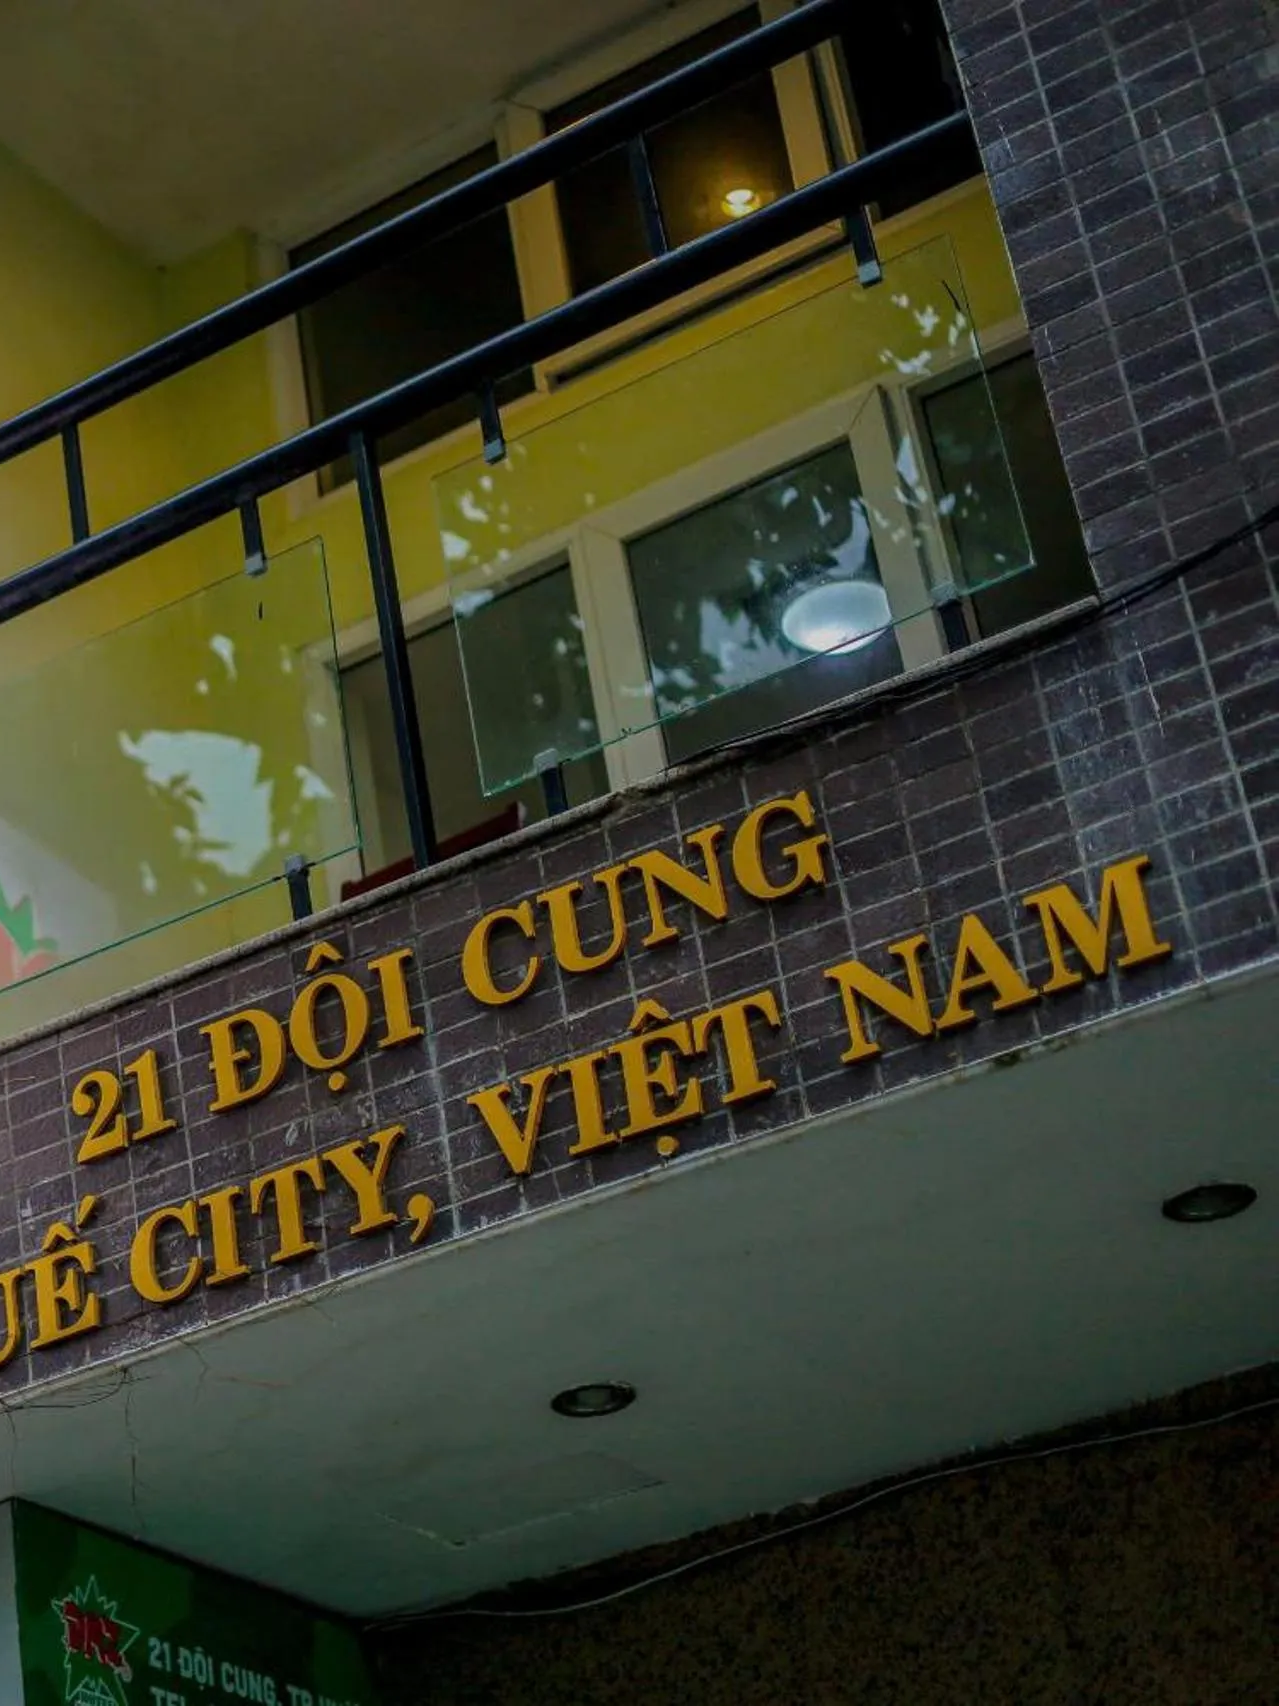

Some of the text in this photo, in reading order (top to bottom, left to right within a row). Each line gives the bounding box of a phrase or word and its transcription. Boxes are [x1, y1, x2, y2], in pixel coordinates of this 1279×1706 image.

[70, 790, 828, 1165] 21 ĐỘI CUNG
[130, 1125, 436, 1306] CITY,
[467, 990, 781, 1175] VIỆT
[825, 855, 1174, 1065] NAM
[148, 1637, 171, 1672] 21
[177, 1646, 216, 1691] ĐỘI
